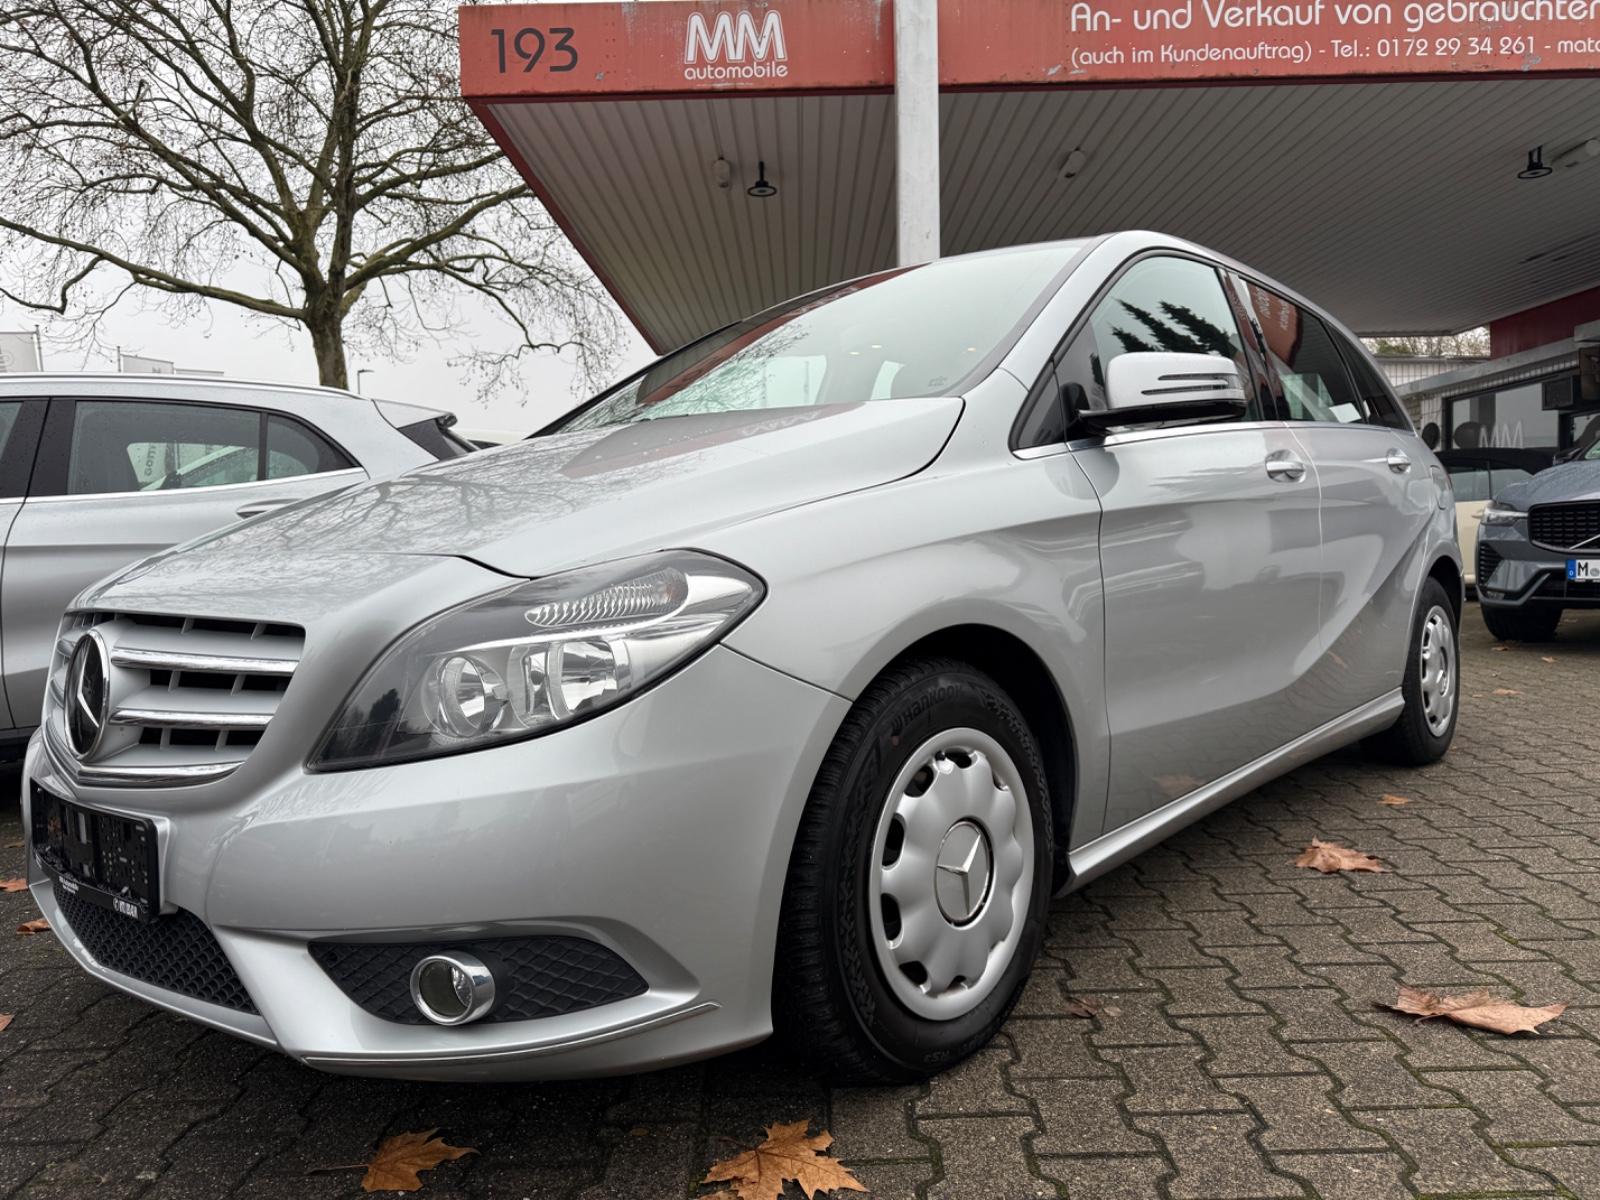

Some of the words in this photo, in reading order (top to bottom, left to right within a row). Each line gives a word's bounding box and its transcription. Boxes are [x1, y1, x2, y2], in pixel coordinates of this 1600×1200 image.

[1071, 2, 1122, 32] An-
[1133, 0, 1192, 31] und
[1202, 0, 1325, 28] Verkauf
[1334, 3, 1392, 25] von
[490, 27, 578, 74] 193
[685, 10, 787, 64] MM
[1071, 46, 1125, 69] (auch
[1132, 47, 1154, 63] im
[1160, 40, 1312, 64] Kundenauftrag)
[1330, 39, 1370, 58] Tel.:
[1377, 38, 1429, 57] 0172
[1434, 37, 1461, 56] 29
[1467, 36, 1493, 56] 34
[1499, 35, 1534, 55] 261
[684, 61, 789, 80] automobile
[1577, 561, 1589, 577] M
